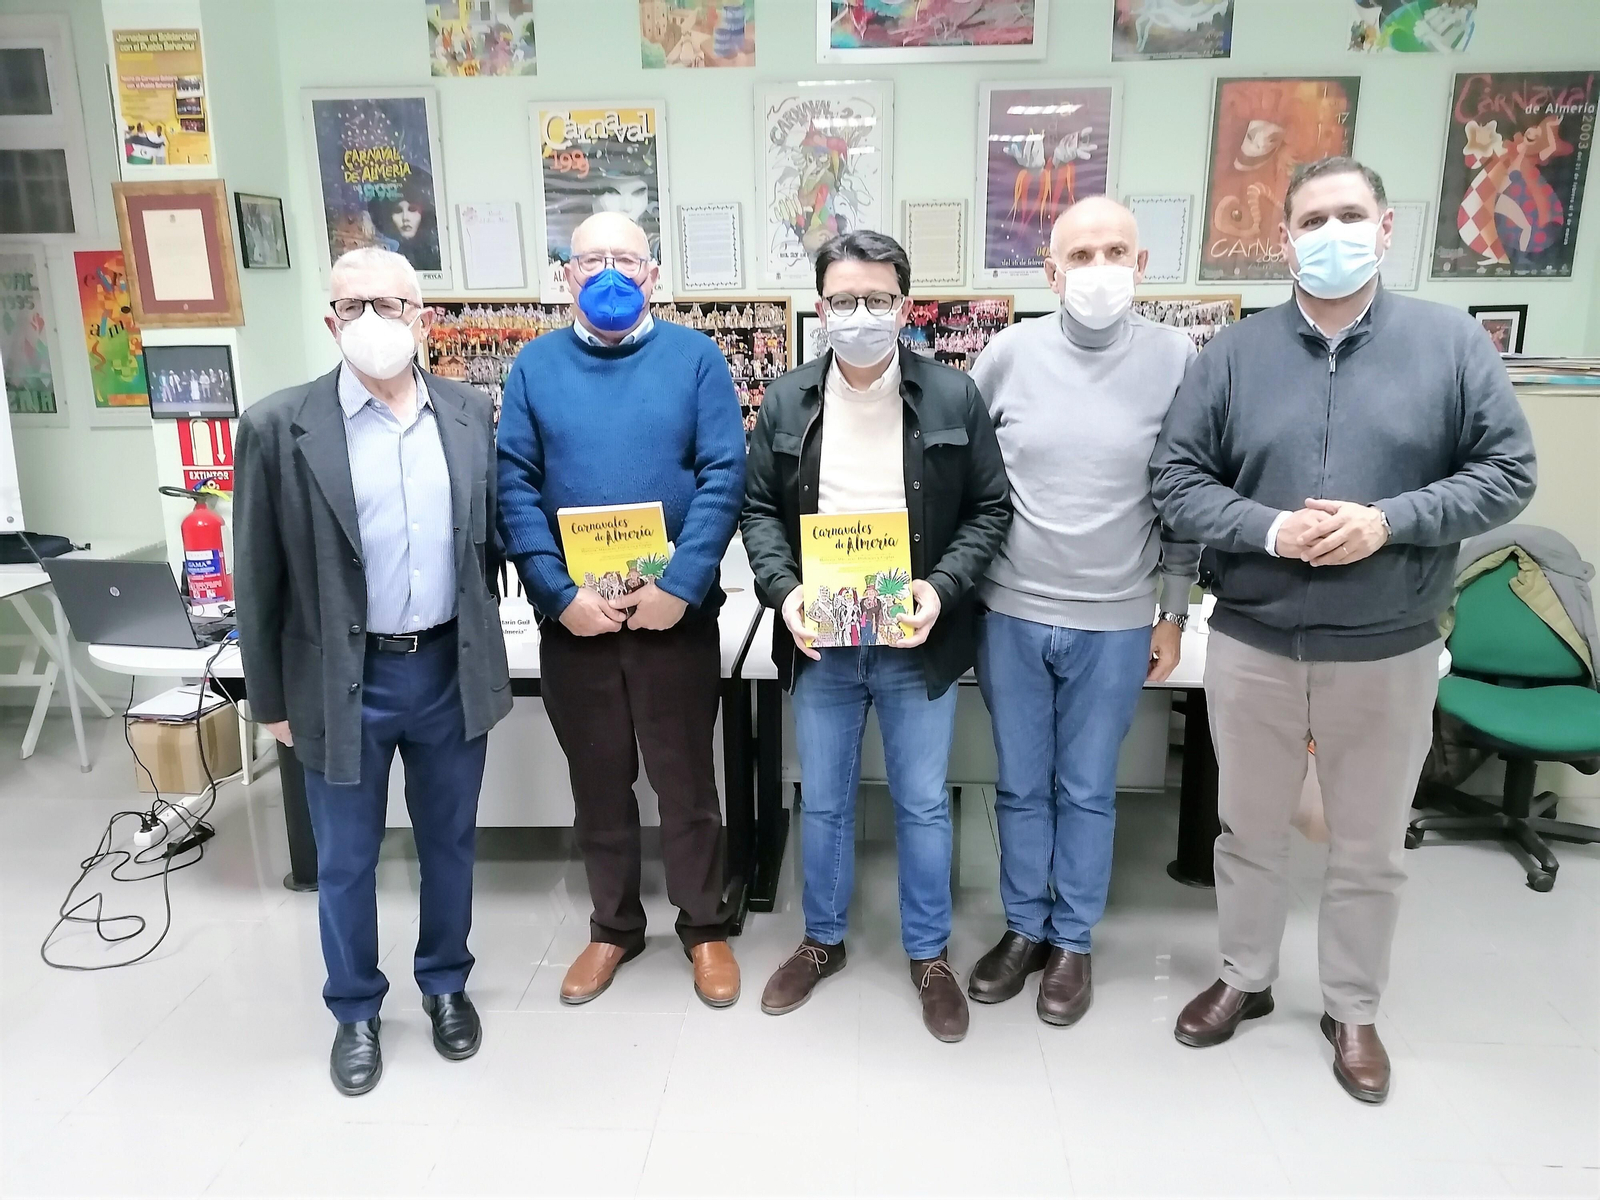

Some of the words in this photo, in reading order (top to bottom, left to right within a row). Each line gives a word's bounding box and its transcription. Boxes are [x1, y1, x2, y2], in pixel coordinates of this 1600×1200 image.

[1525, 104, 1540, 115] de
[542, 110, 655, 150] Carnaval
[1578, 116, 1594, 150] 2003
[344, 146, 405, 171] CARNAVAL
[344, 171, 360, 183] DE
[1027, 257, 1044, 266] febrer
[189, 470, 229, 480] EXTINTOR
[571, 515, 629, 535] Carnavales
[594, 532, 605, 542] de
[606, 524, 654, 547] Almería
[812, 519, 873, 540] Carnavales
[835, 538, 845, 549] de
[846, 532, 899, 556] Almería
